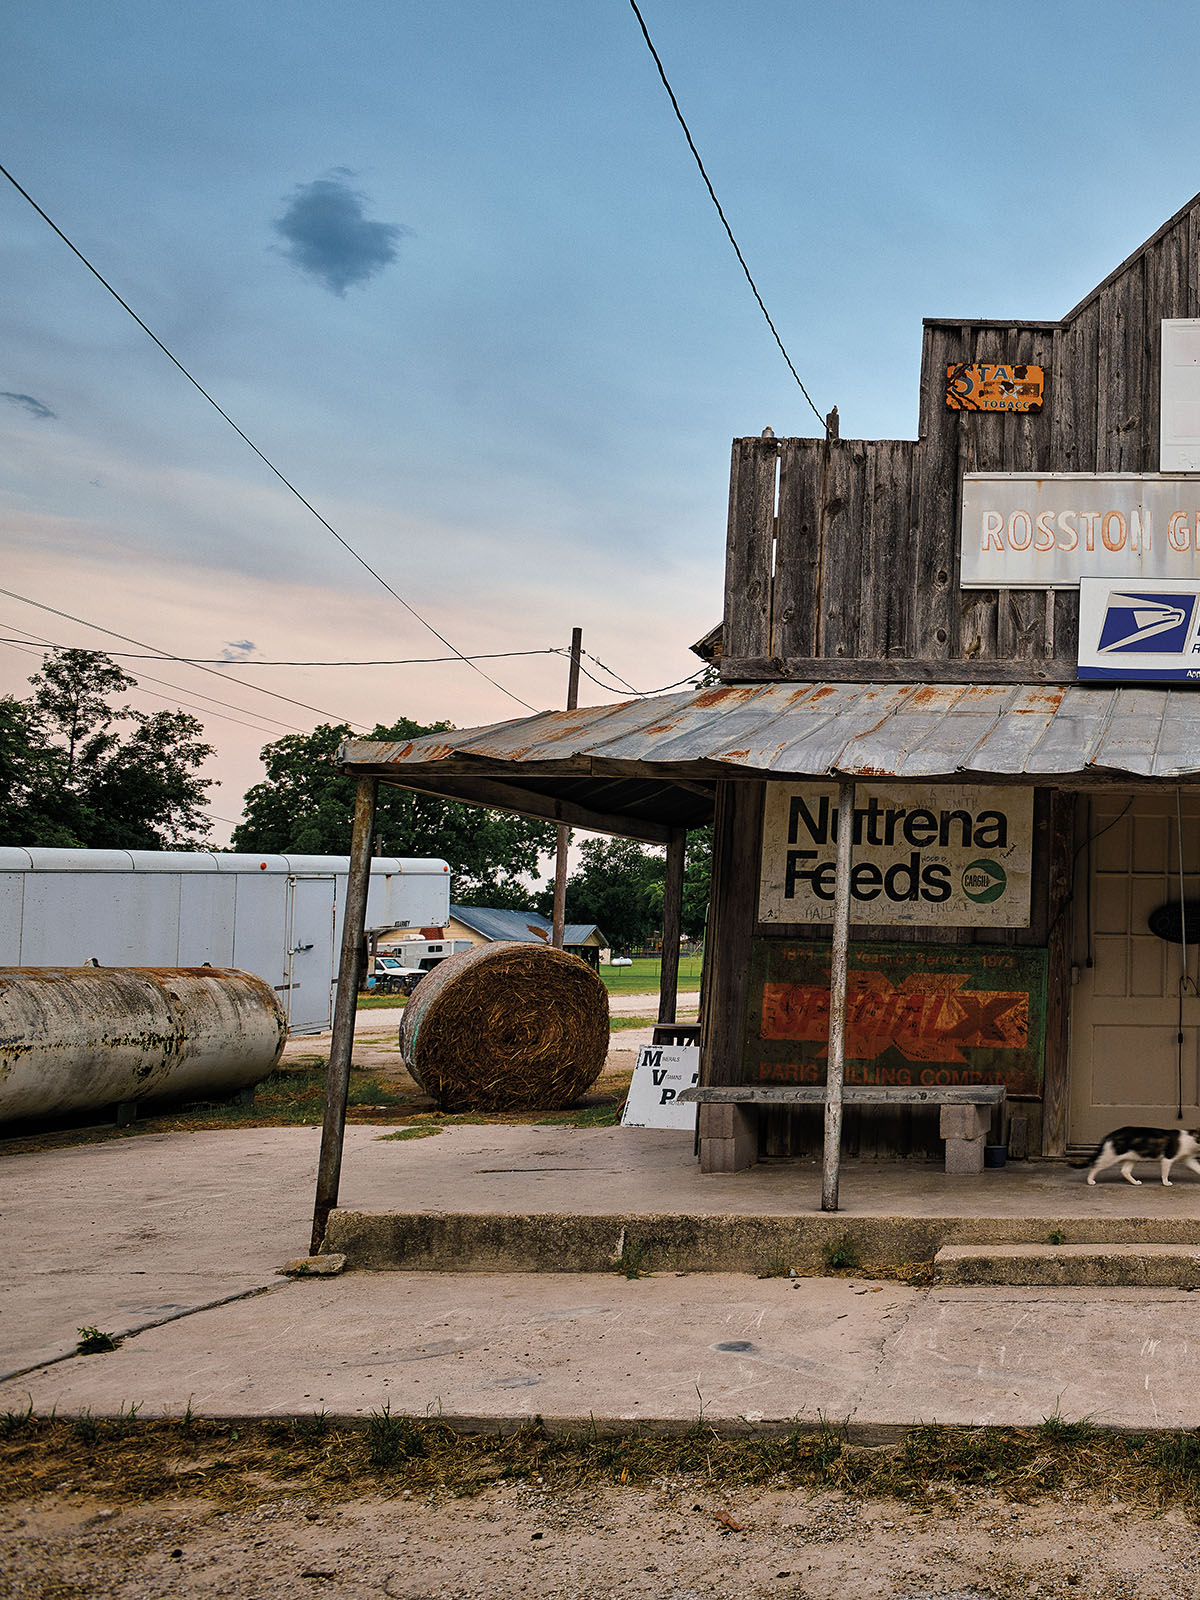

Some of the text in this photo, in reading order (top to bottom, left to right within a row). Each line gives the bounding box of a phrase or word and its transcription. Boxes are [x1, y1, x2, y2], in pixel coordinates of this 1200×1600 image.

[951, 365, 1029, 397] STA
[983, 400, 1032, 410] TOBACC
[981, 510, 1152, 551] ROSSTON
[787, 796, 1008, 848] Nutrena
[784, 850, 952, 903] Feeds
[982, 954, 1014, 969] 1973
[759, 1062, 819, 1083] PARIS
[844, 1065, 912, 1086] ILLING
